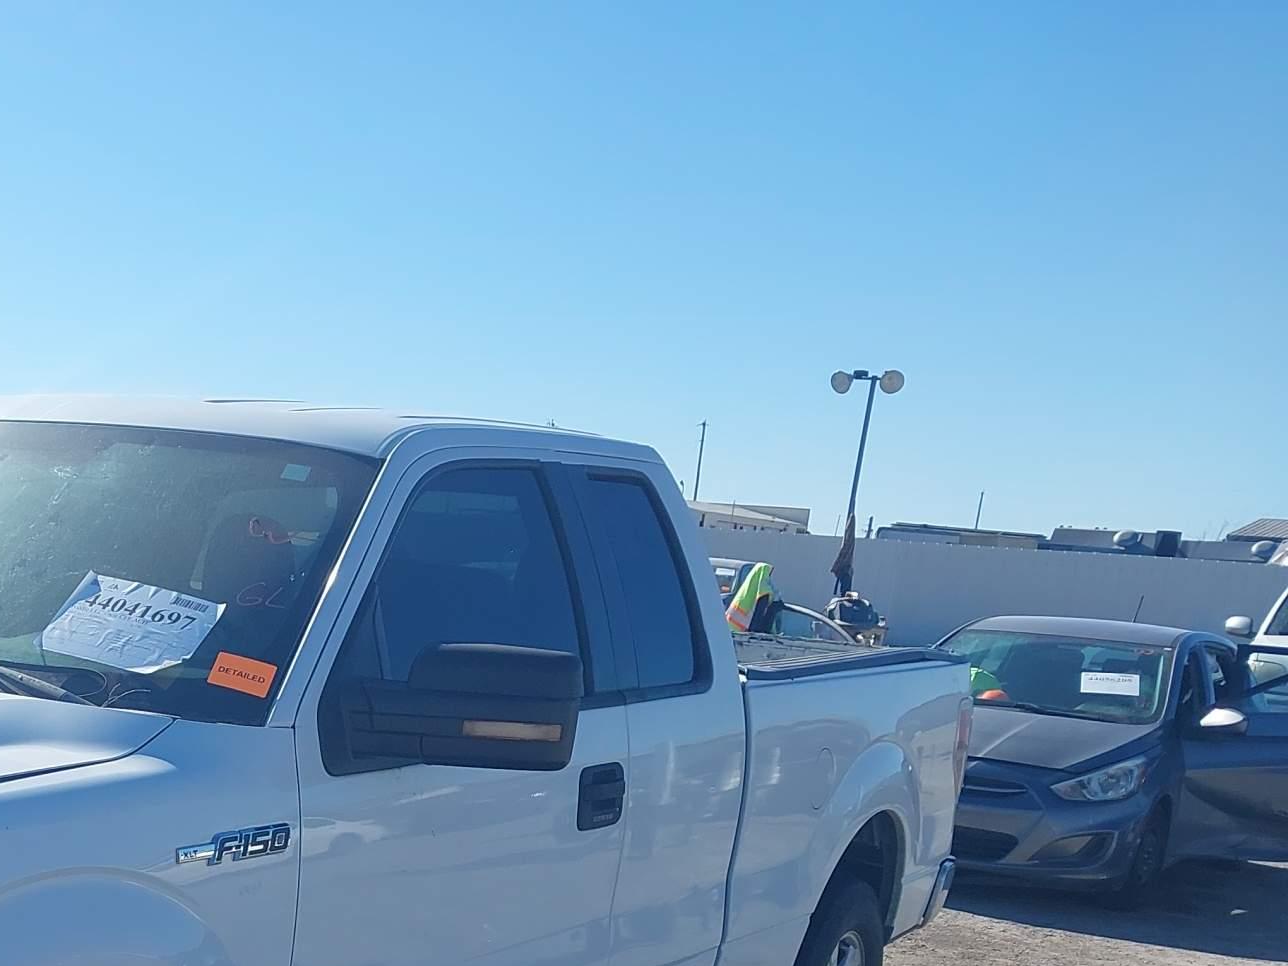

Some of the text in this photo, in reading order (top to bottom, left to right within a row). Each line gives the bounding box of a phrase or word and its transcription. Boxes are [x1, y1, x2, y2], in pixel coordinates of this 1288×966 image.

[85, 593, 197, 630] 44041697
[218, 665, 265, 684] DETAILED
[183, 849, 198, 859] XLT
[215, 825, 291, 862] F-150
